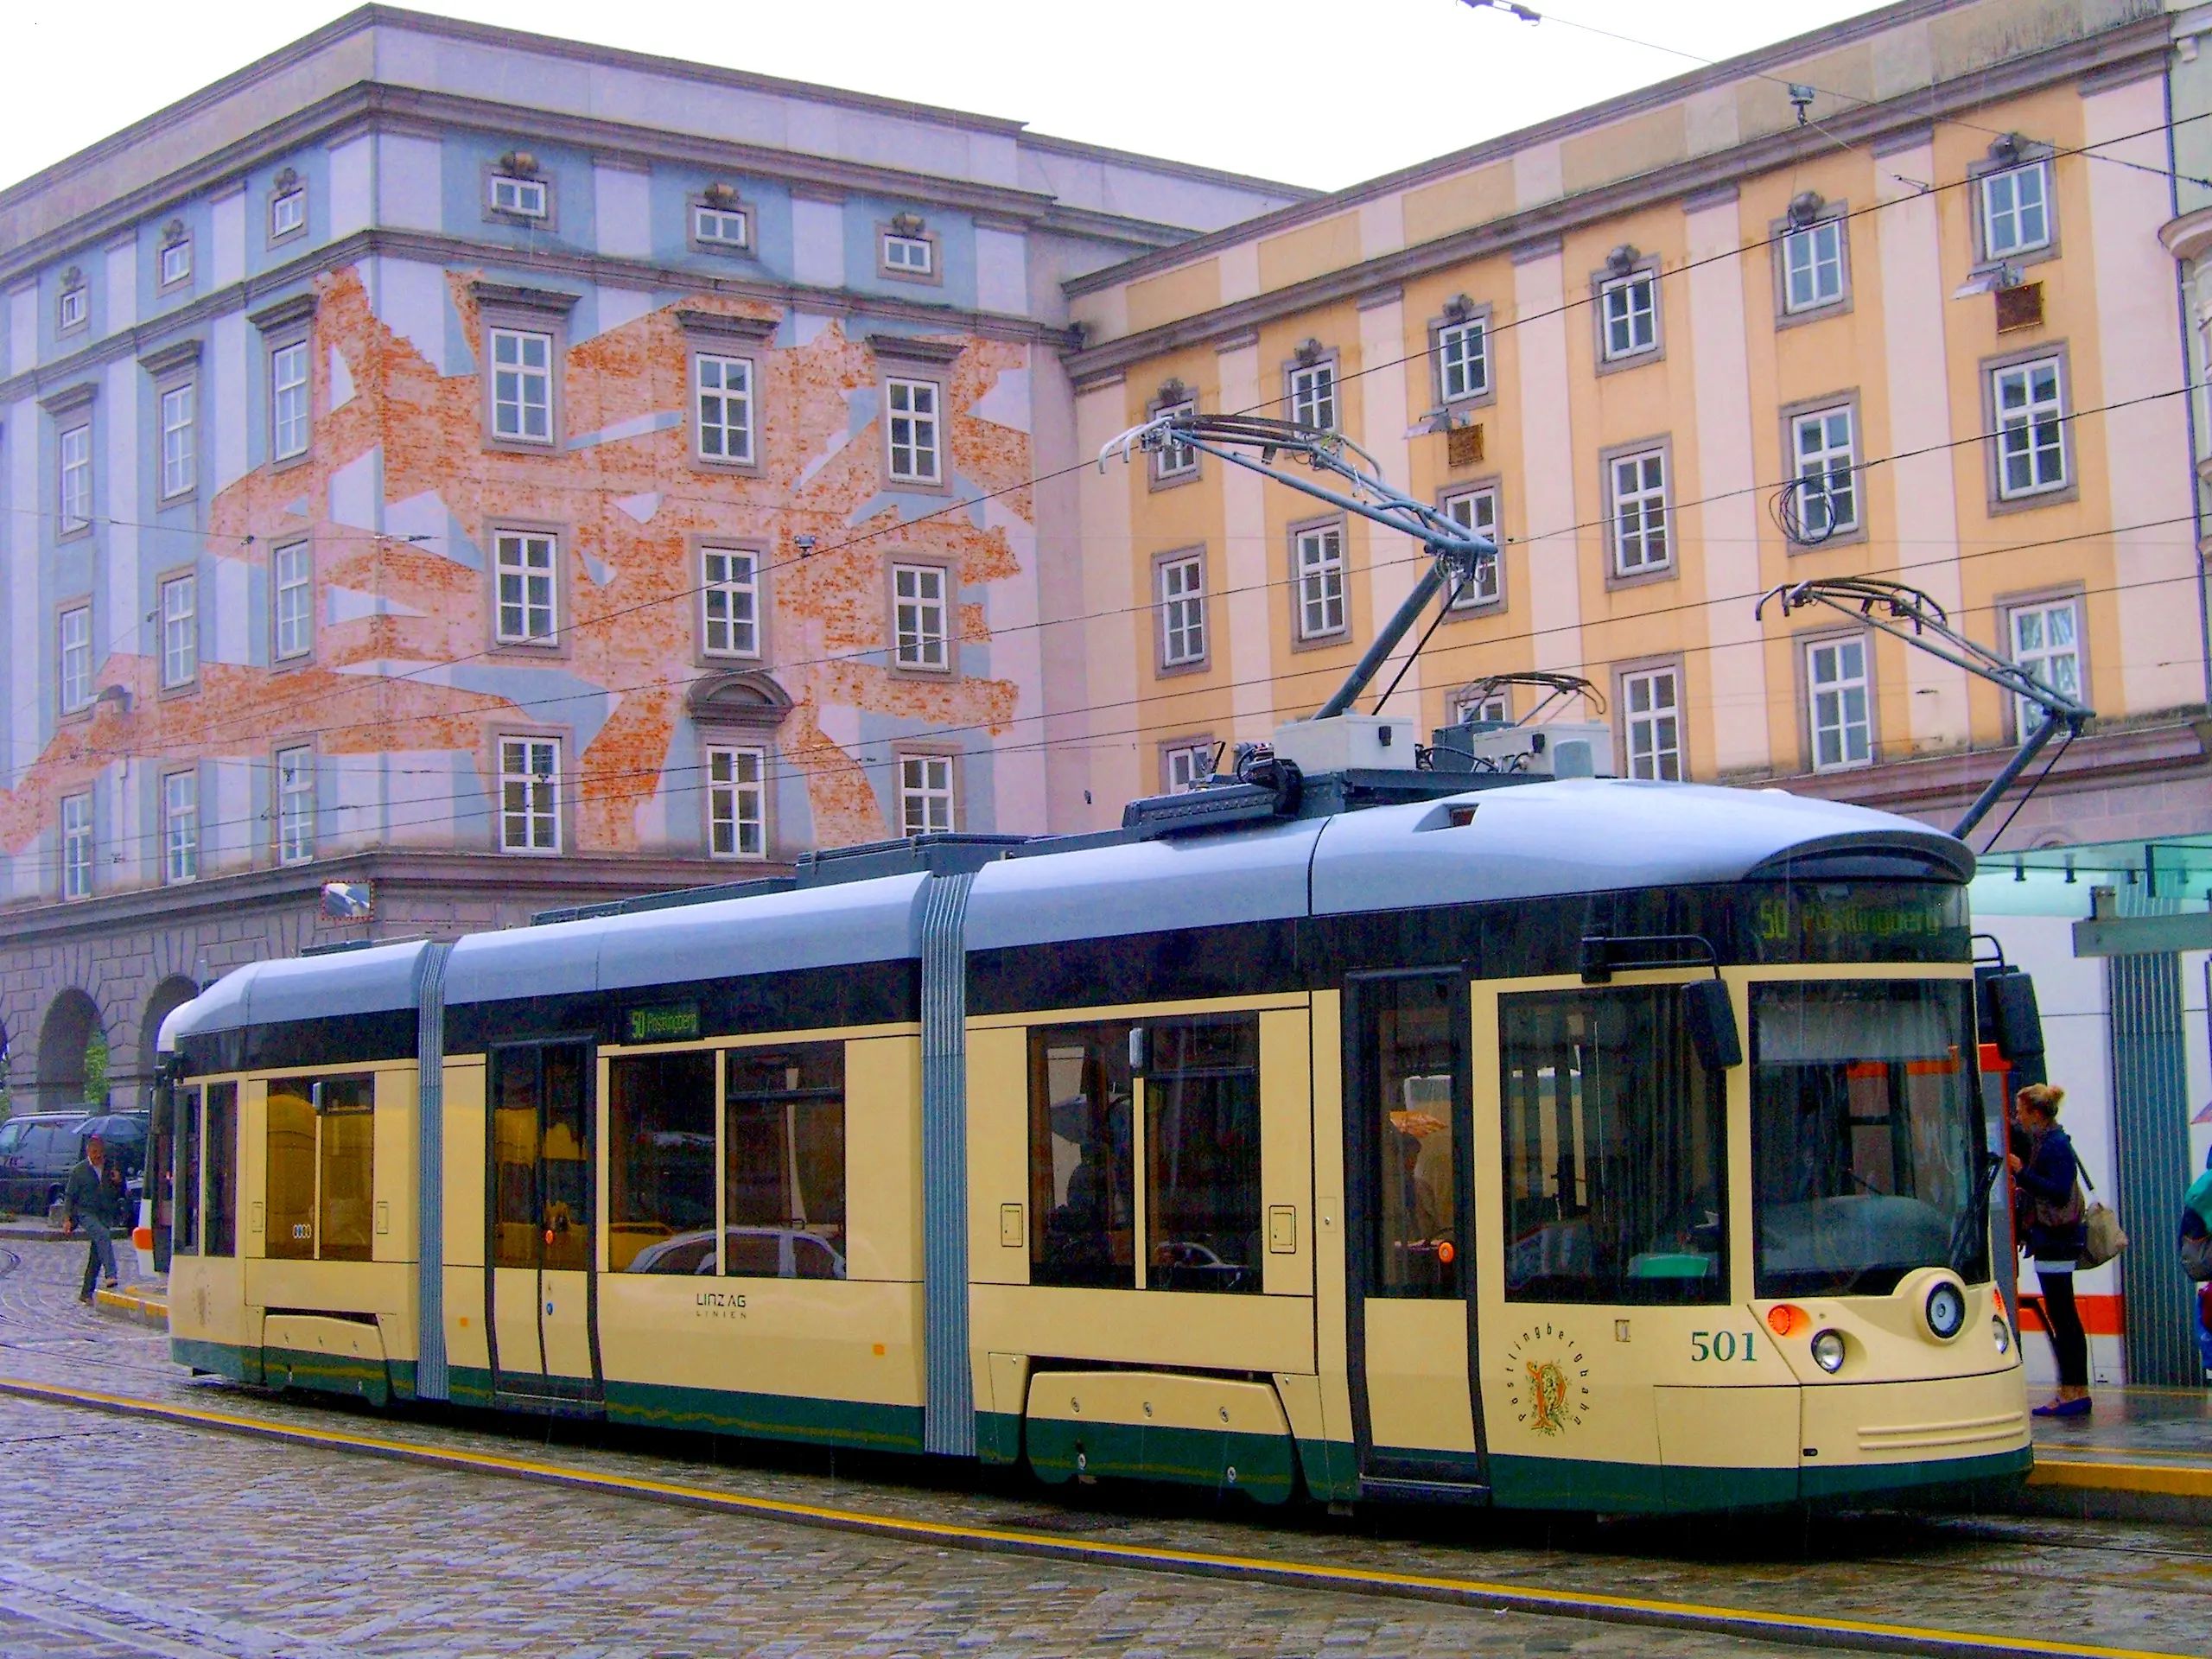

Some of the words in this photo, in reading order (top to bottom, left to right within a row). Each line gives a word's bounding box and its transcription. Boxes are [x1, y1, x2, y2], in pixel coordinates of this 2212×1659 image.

[696, 1294, 724, 1306] LINZ
[728, 1294, 747, 1307] AG
[1691, 1331, 1758, 1362] 501
